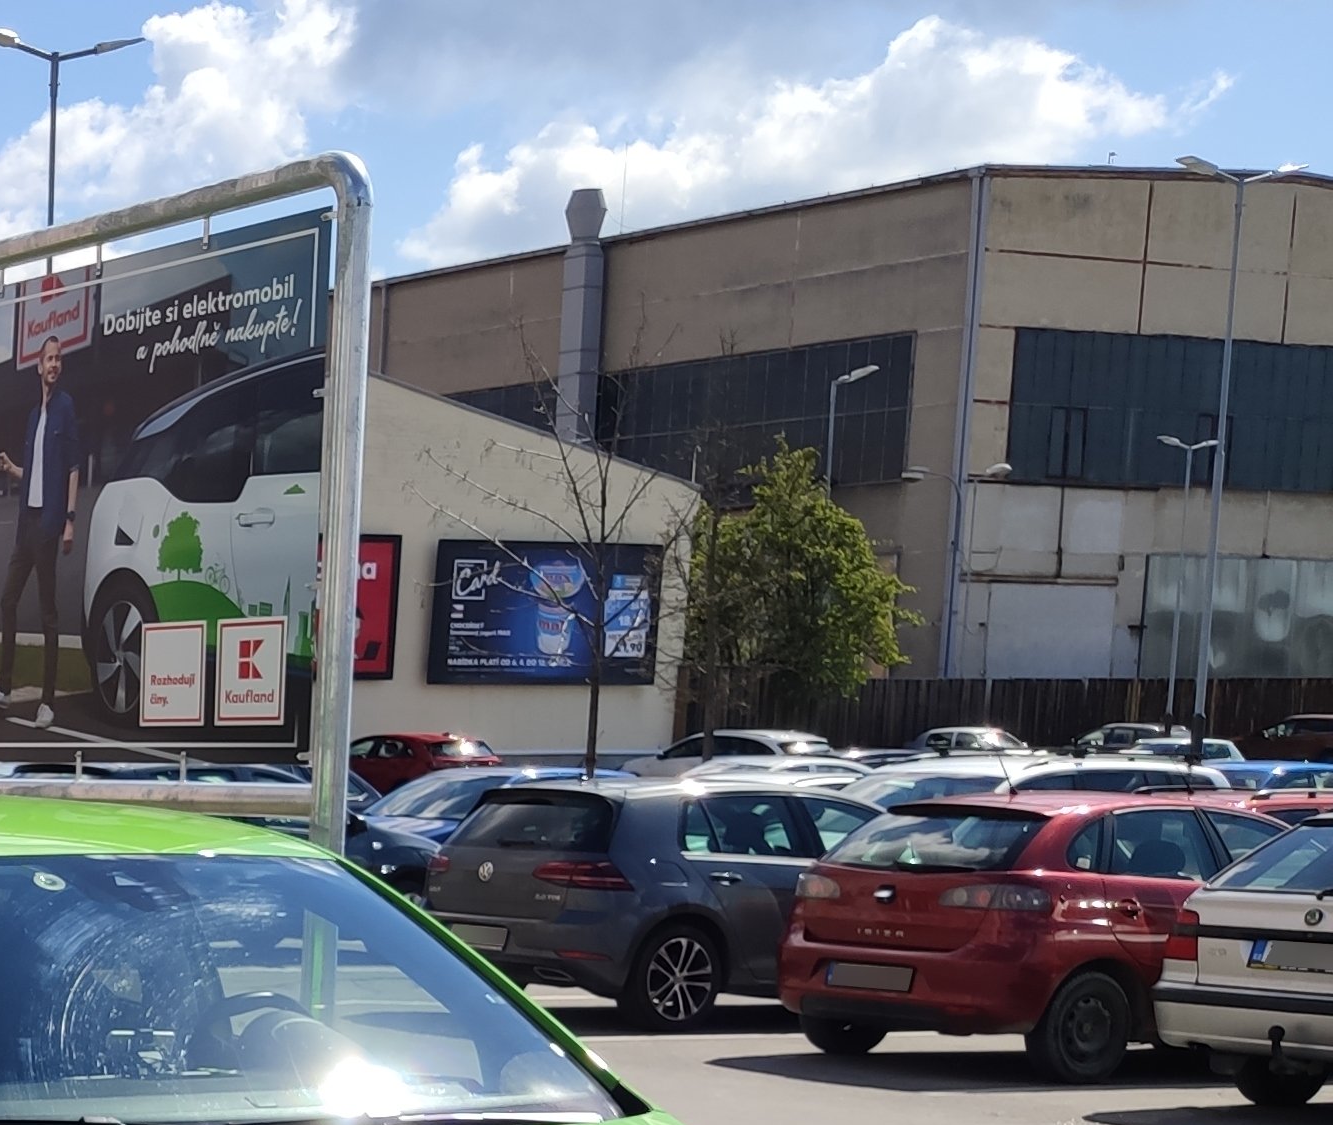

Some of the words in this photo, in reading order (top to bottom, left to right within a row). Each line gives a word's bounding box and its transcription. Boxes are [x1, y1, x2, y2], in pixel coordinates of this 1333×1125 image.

[103, 308, 161, 336] Dobijte
[166, 303, 179, 323] si
[182, 274, 295, 320] elektromobil
[27, 303, 80, 339] Kaufland
[136, 346, 147, 361] a
[149, 322, 221, 373] pohodlně
[225, 298, 302, 354] nakupte!
[456, 560, 500, 596] Card
[447, 657, 478, 666] NABÍDKA
[480, 657, 499, 666] PLATÍ
[150, 674, 196, 688] Rozhodují
[225, 690, 274, 704] Kaufland
[857, 927, 904, 938] IBIZA
